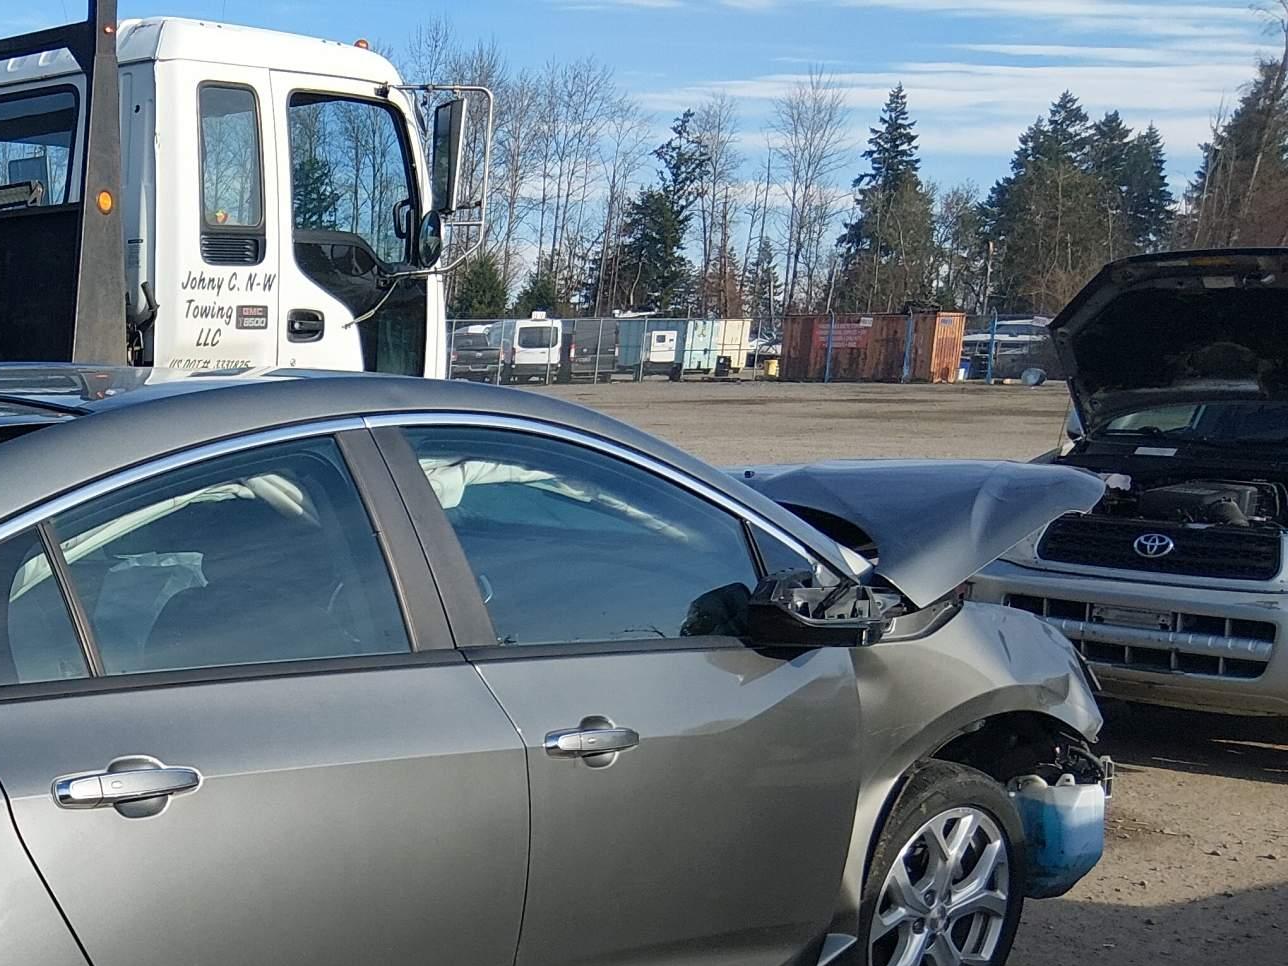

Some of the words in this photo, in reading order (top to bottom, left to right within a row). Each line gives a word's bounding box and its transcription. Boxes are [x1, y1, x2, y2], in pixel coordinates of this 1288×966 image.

[181, 270, 225, 296] Johny
[228, 271, 240, 292] C.
[245, 272, 277, 292] N-W
[185, 298, 234, 326] Towing
[242, 307, 264, 316] GMC
[195, 327, 222, 347] LLC
